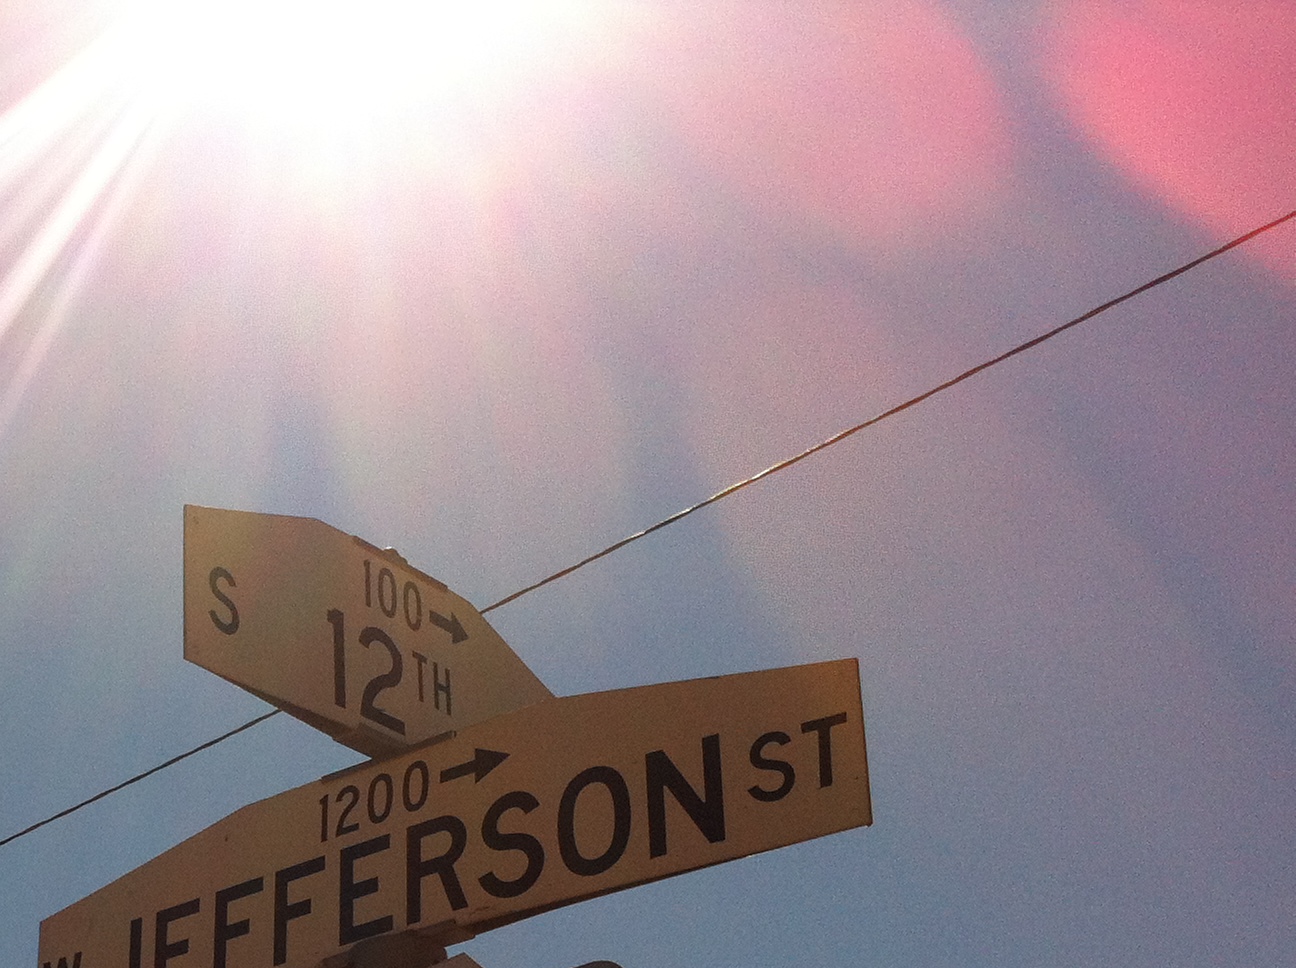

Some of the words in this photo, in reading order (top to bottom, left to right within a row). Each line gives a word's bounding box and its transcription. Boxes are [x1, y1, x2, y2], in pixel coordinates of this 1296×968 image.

[363, 559, 423, 632] 100
[208, 565, 241, 636] S
[326, 607, 453, 736] 12TH
[318, 758, 430, 844] 1200
[747, 711, 848, 803] ST
